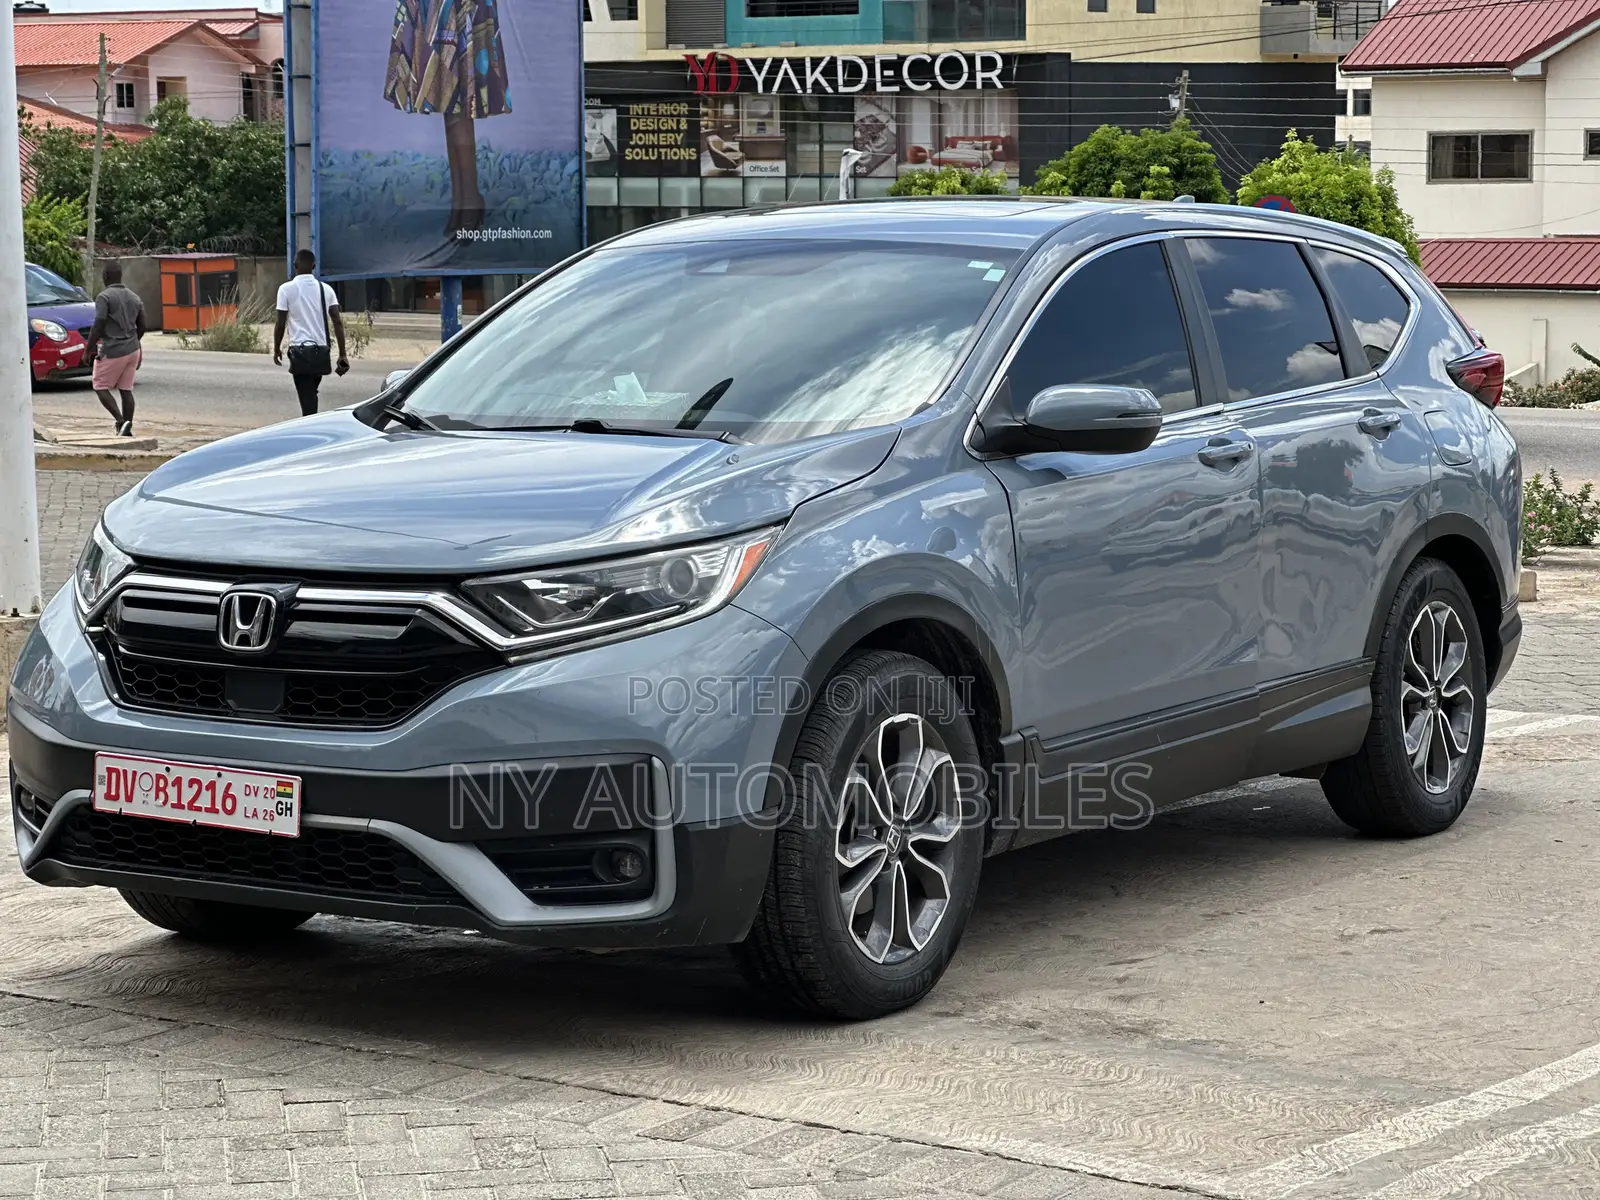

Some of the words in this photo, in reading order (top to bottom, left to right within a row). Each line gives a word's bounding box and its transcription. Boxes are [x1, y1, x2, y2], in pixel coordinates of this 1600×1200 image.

[744, 51, 1004, 94] YAKDECOR
[629, 102, 689, 115] INTERIOR
[630, 118, 678, 131] DESIGN
[679, 118, 688, 130] &
[629, 133, 684, 145] JOINERY
[625, 148, 698, 160] SOLUTIONS
[749, 164, 768, 173] Office
[769, 164, 780, 173] Set
[855, 165, 867, 173] Set
[456, 226, 552, 242] shop.gtpfashion.com
[104, 766, 138, 803] DV
[155, 773, 237, 815] B1216
[244, 784, 260, 798] DV
[263, 786, 276, 799] 20
[244, 806, 259, 819] LA
[262, 808, 275, 821] 26
[275, 800, 293, 817] GH
